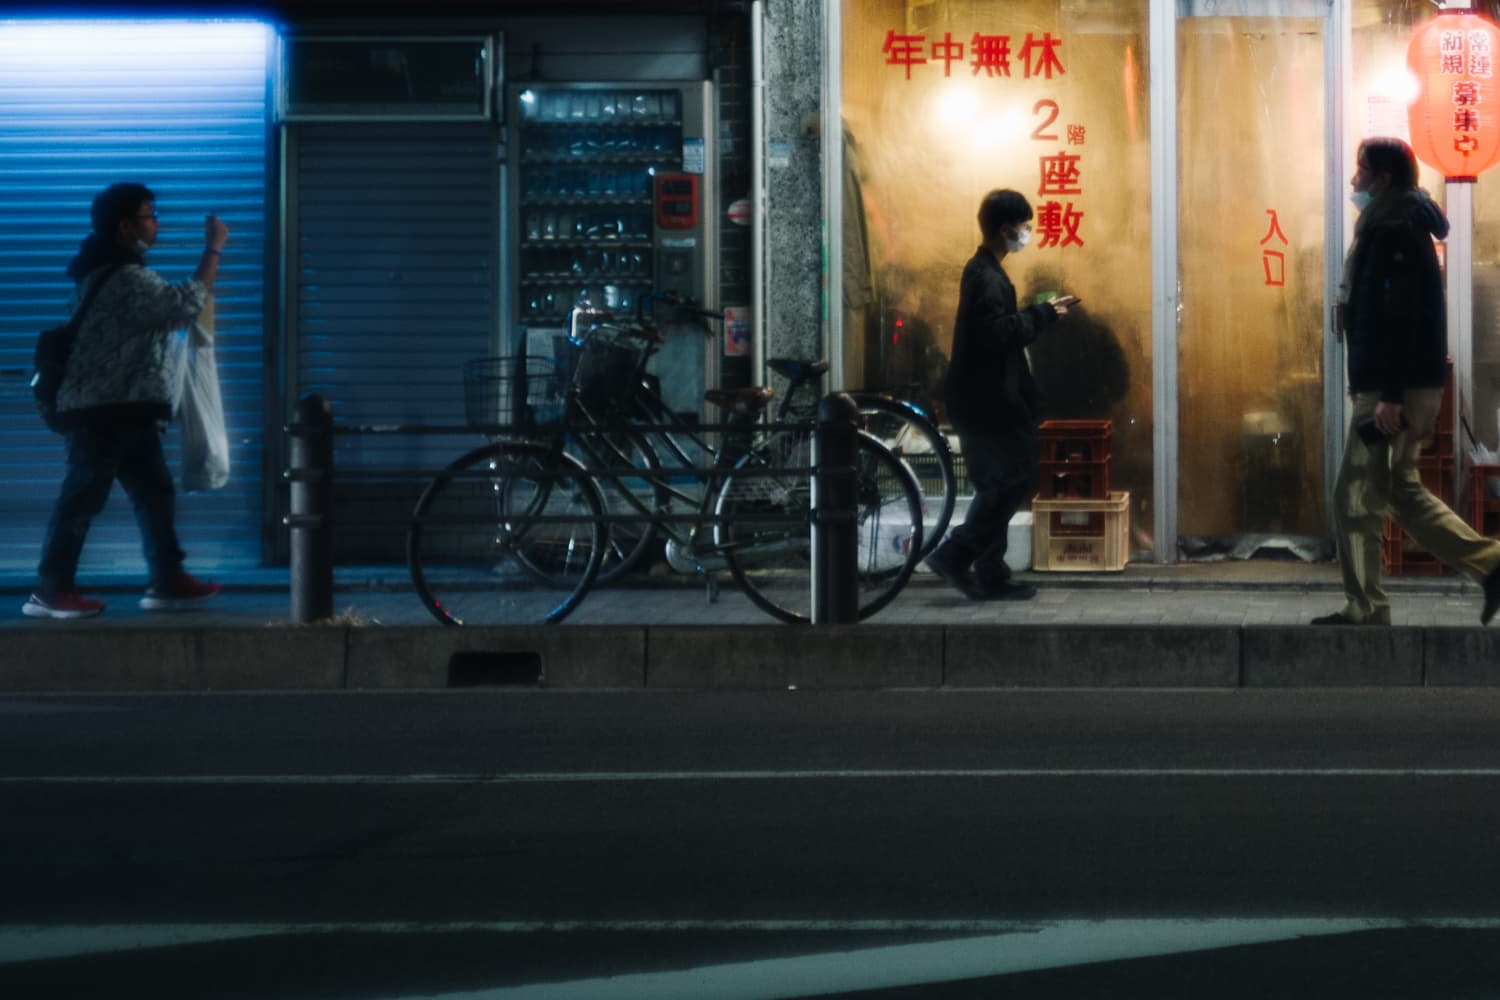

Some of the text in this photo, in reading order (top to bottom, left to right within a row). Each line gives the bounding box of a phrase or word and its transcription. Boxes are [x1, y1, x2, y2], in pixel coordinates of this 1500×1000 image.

[882, 30, 1066, 80] 年中無休
[1259, 209, 1289, 287] 入口
